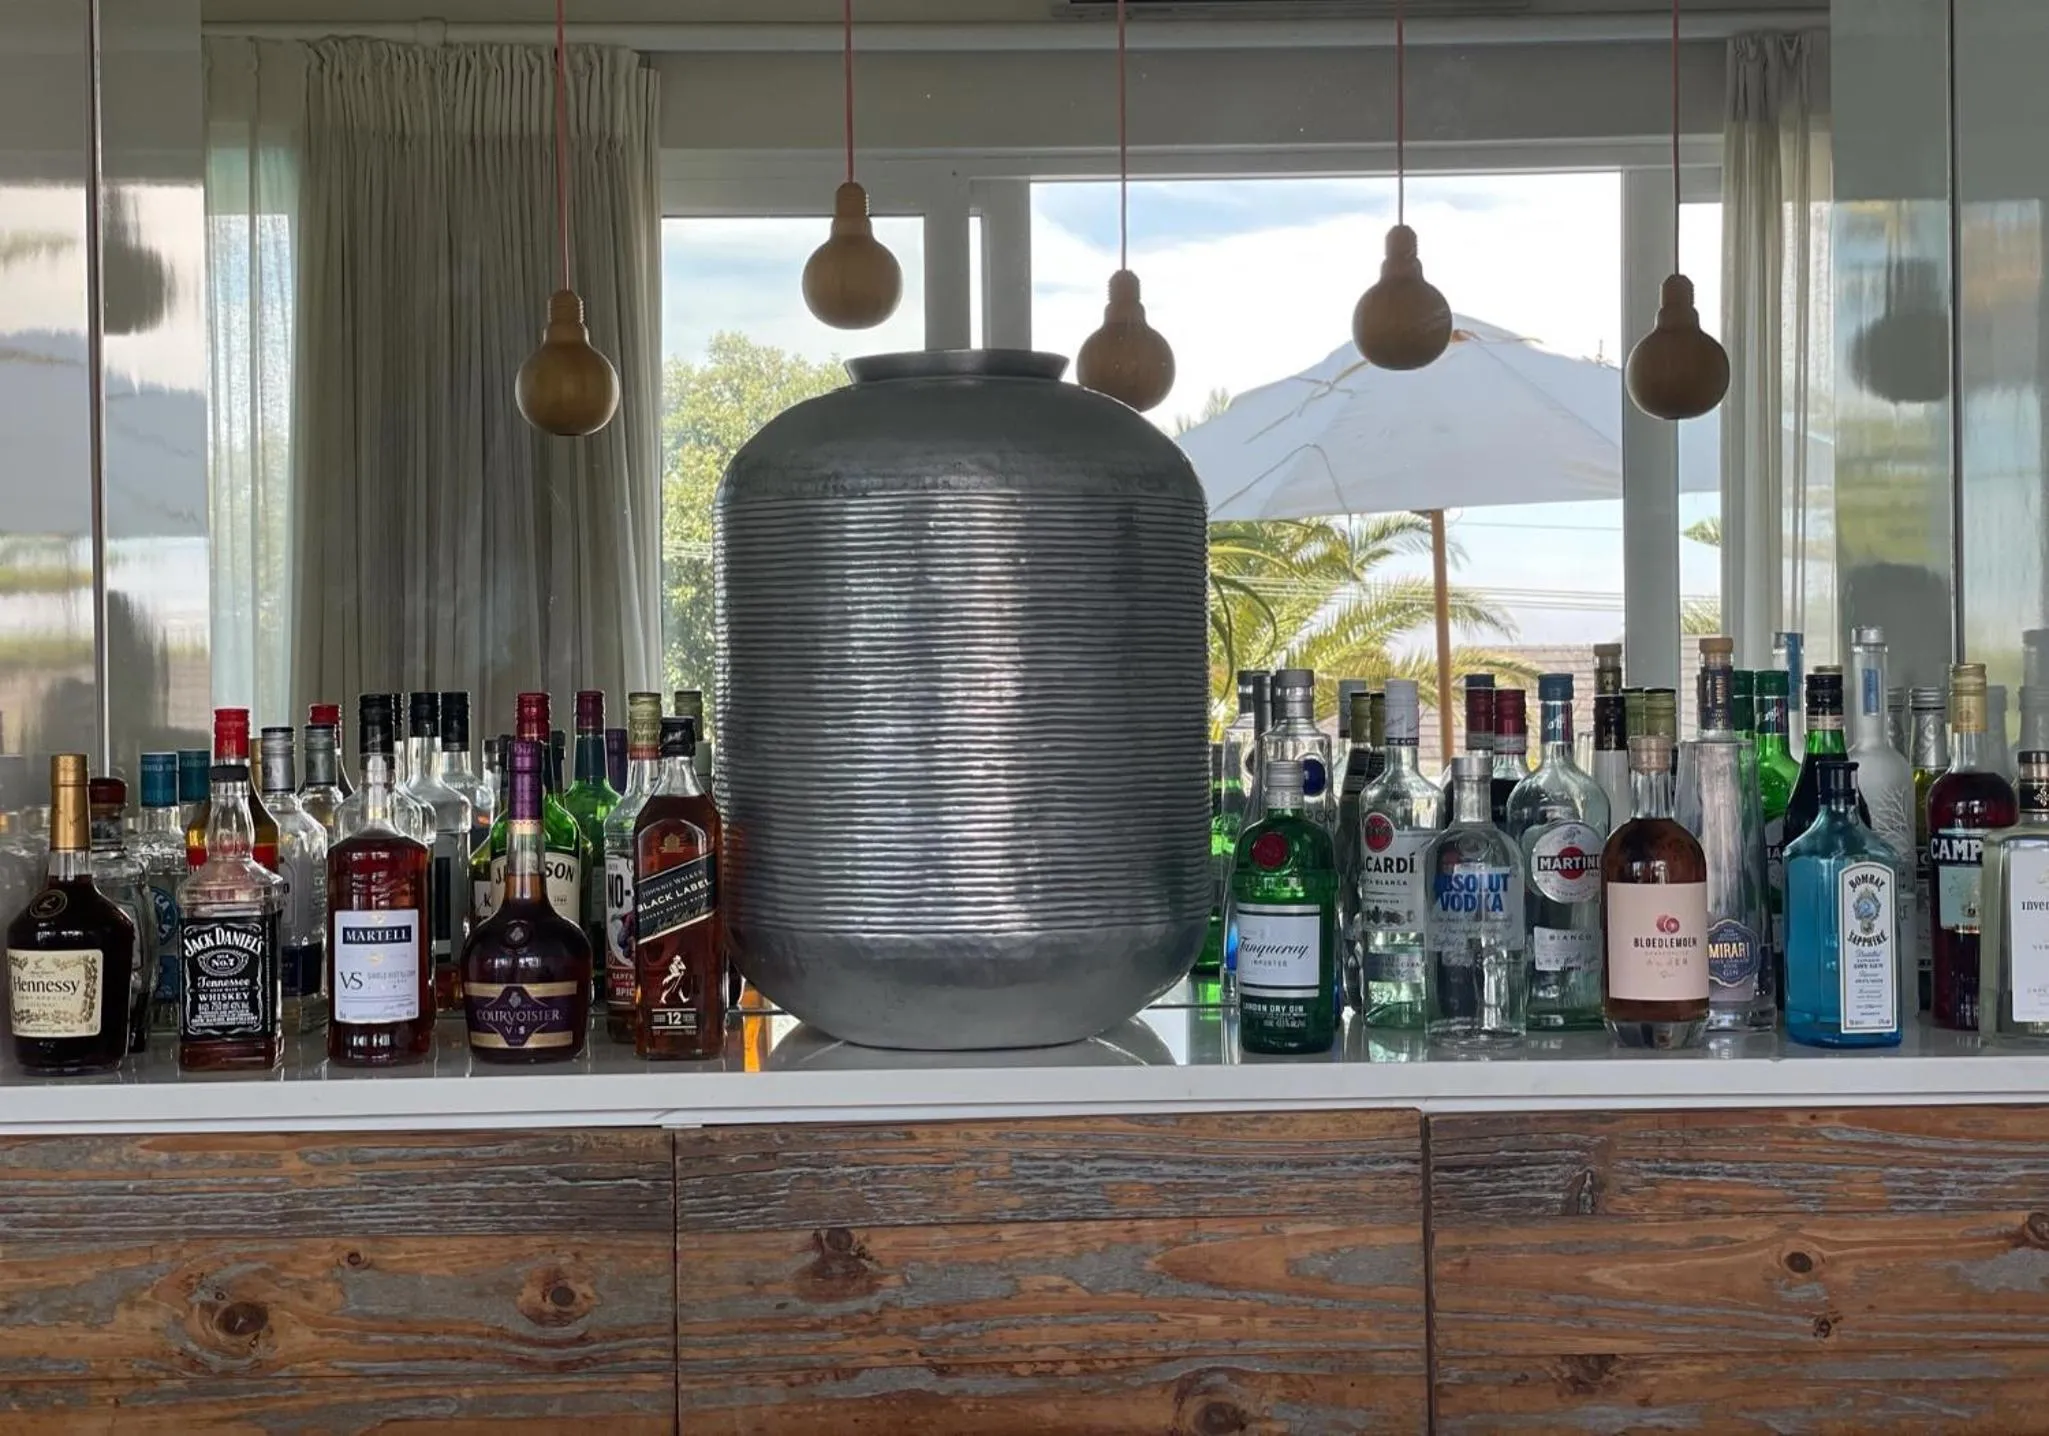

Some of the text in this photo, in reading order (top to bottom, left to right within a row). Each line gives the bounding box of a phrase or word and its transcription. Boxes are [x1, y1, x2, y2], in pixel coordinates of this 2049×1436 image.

[1931, 838, 1983, 861] CAMP
[1365, 851, 1416, 874] CARDÍ
[496, 861, 574, 885] JSON
[1435, 873, 1509, 893] ABSOLUT
[1848, 873, 1886, 893] BOMBAY
[637, 878, 712, 913] BLACK LABEL
[1440, 893, 1504, 912] VODKA
[184, 927, 265, 958] JACK DANIEL'S
[346, 928, 408, 942] MARTELL
[1633, 936, 1697, 949] BLOEDLEMOEN
[1239, 936, 1309, 960] Tanqueray
[1708, 941, 1750, 959] MIRARI
[13, 975, 81, 996] Hennessy
[197, 976, 251, 988] Tennessee
[339, 971, 363, 990] VS
[198, 992, 250, 1002] WHISKEY
[475, 1007, 560, 1025] COURVOISIER
[666, 1011, 682, 1025] 12
[1269, 1004, 1287, 1013] DRY
[1288, 1004, 1304, 1014] GIN
